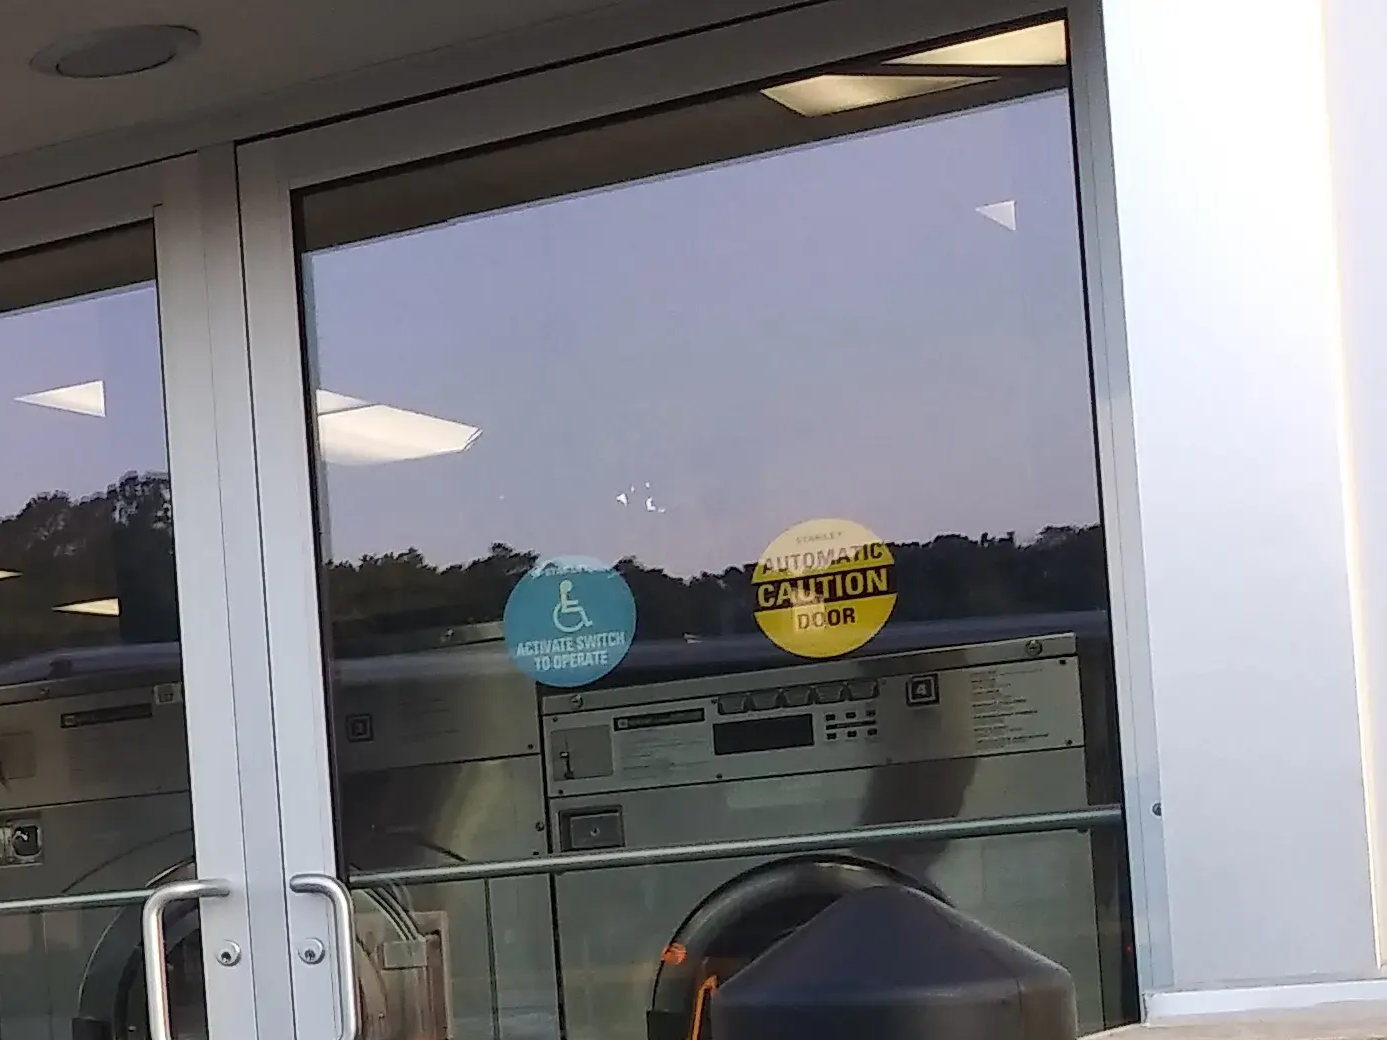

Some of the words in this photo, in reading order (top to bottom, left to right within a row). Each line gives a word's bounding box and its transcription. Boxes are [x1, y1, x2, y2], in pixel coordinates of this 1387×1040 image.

[762, 542, 883, 575] AUTOMATIC
[757, 568, 888, 608] CAUTION
[797, 607, 856, 630] DOOR
[516, 637, 574, 658] ACTIVATE
[575, 631, 626, 651] SWITCH
[535, 656, 552, 671] TO
[553, 650, 609, 669] OPERATE
